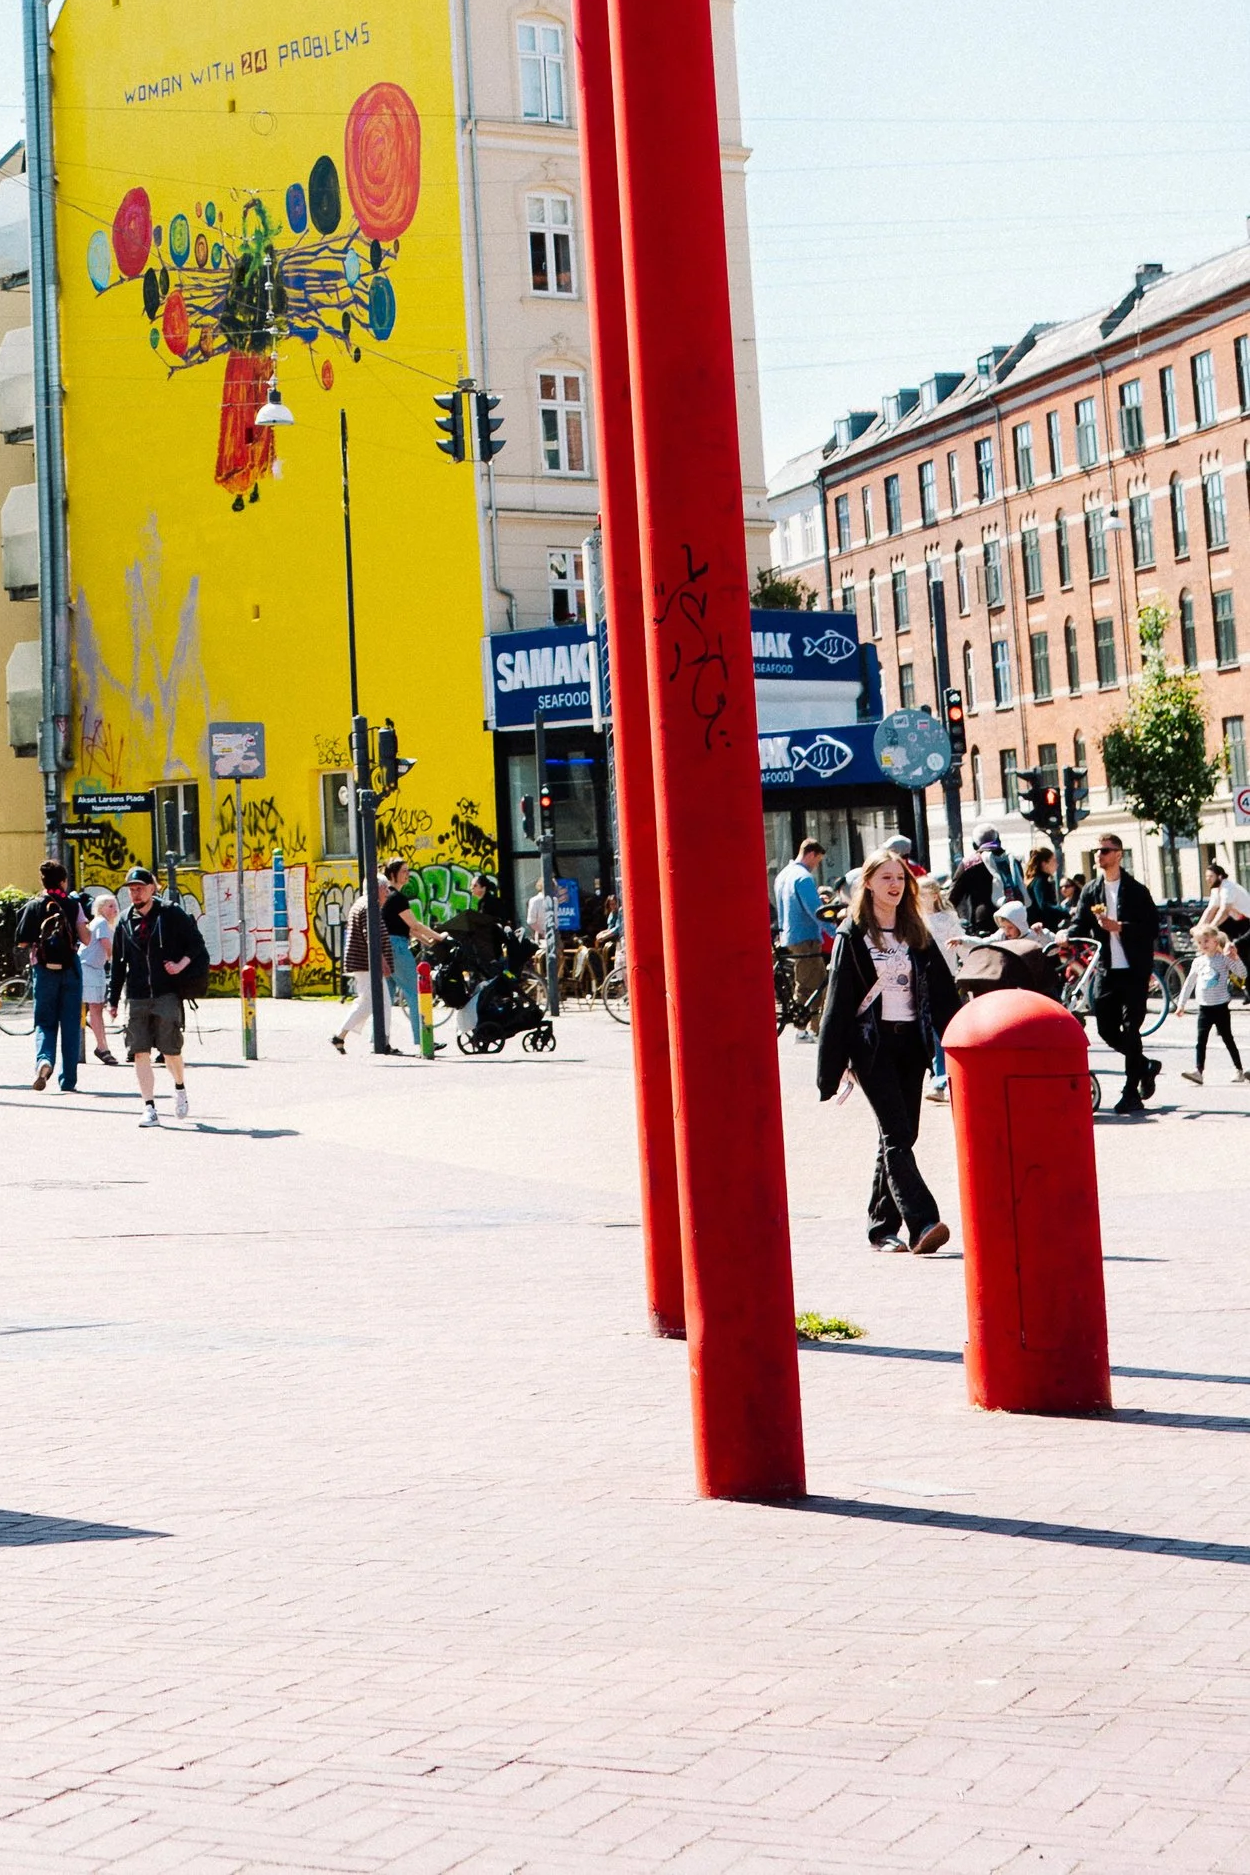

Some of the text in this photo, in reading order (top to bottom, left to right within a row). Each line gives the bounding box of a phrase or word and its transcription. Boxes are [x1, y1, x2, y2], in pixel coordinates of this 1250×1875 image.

[124, 22, 369, 105] WOMAN WITH 24 PROBLEMS
[751, 631, 793, 658] MAK
[496, 643, 590, 693] SAMAK
[755, 663, 794, 674] SEAFOOD
[538, 691, 589, 709] SEAFOOD
[760, 771, 790, 783] AFOOD
